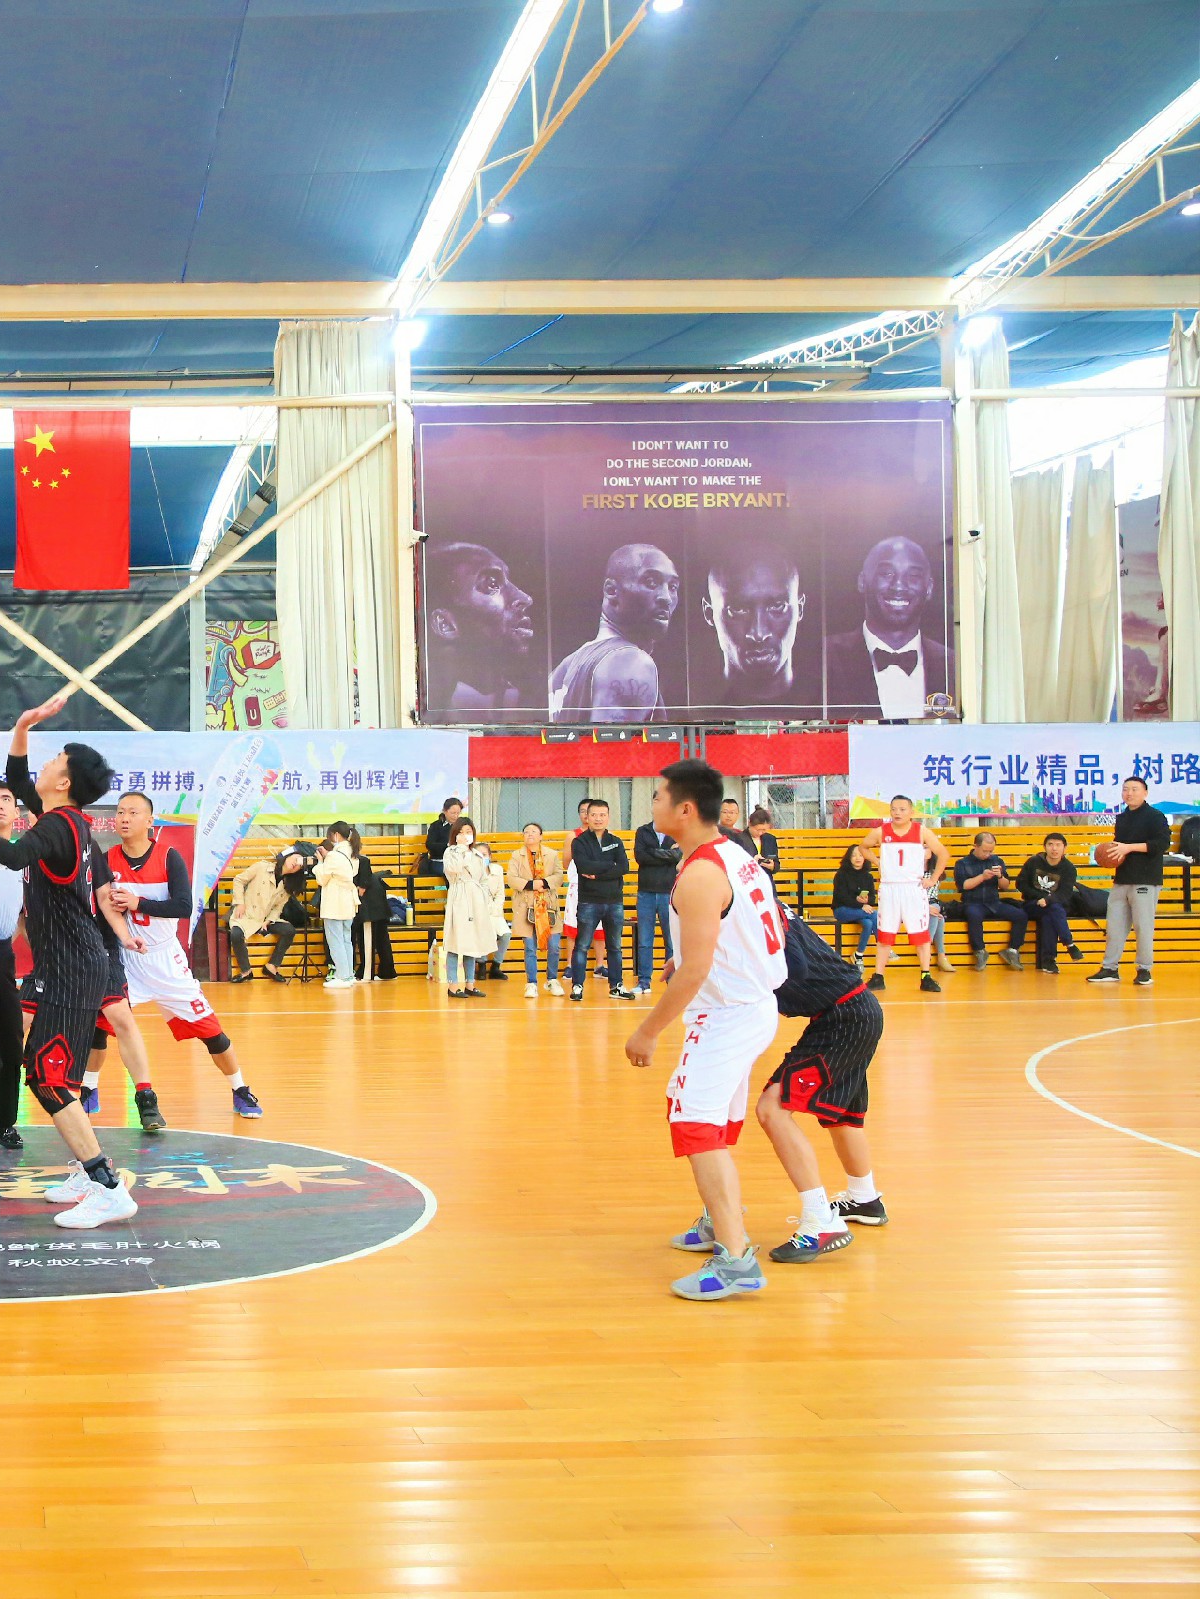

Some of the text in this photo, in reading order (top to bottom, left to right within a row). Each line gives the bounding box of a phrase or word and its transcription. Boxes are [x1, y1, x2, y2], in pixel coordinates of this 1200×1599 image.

[637, 441, 673, 450] DON'T
[675, 441, 710, 450] WANT
[713, 440, 729, 450] TO
[606, 458, 753, 468] DO THE SECOND JORDAN,
[609, 477, 642, 486] ONLY
[644, 476, 679, 486] WANT
[682, 476, 698, 486] TO
[702, 476, 736, 486] MAKE
[738, 476, 762, 485] THE
[582, 493, 639, 509] FIRST
[644, 493, 699, 509] KOBE
[897, 849, 904, 867] 1
